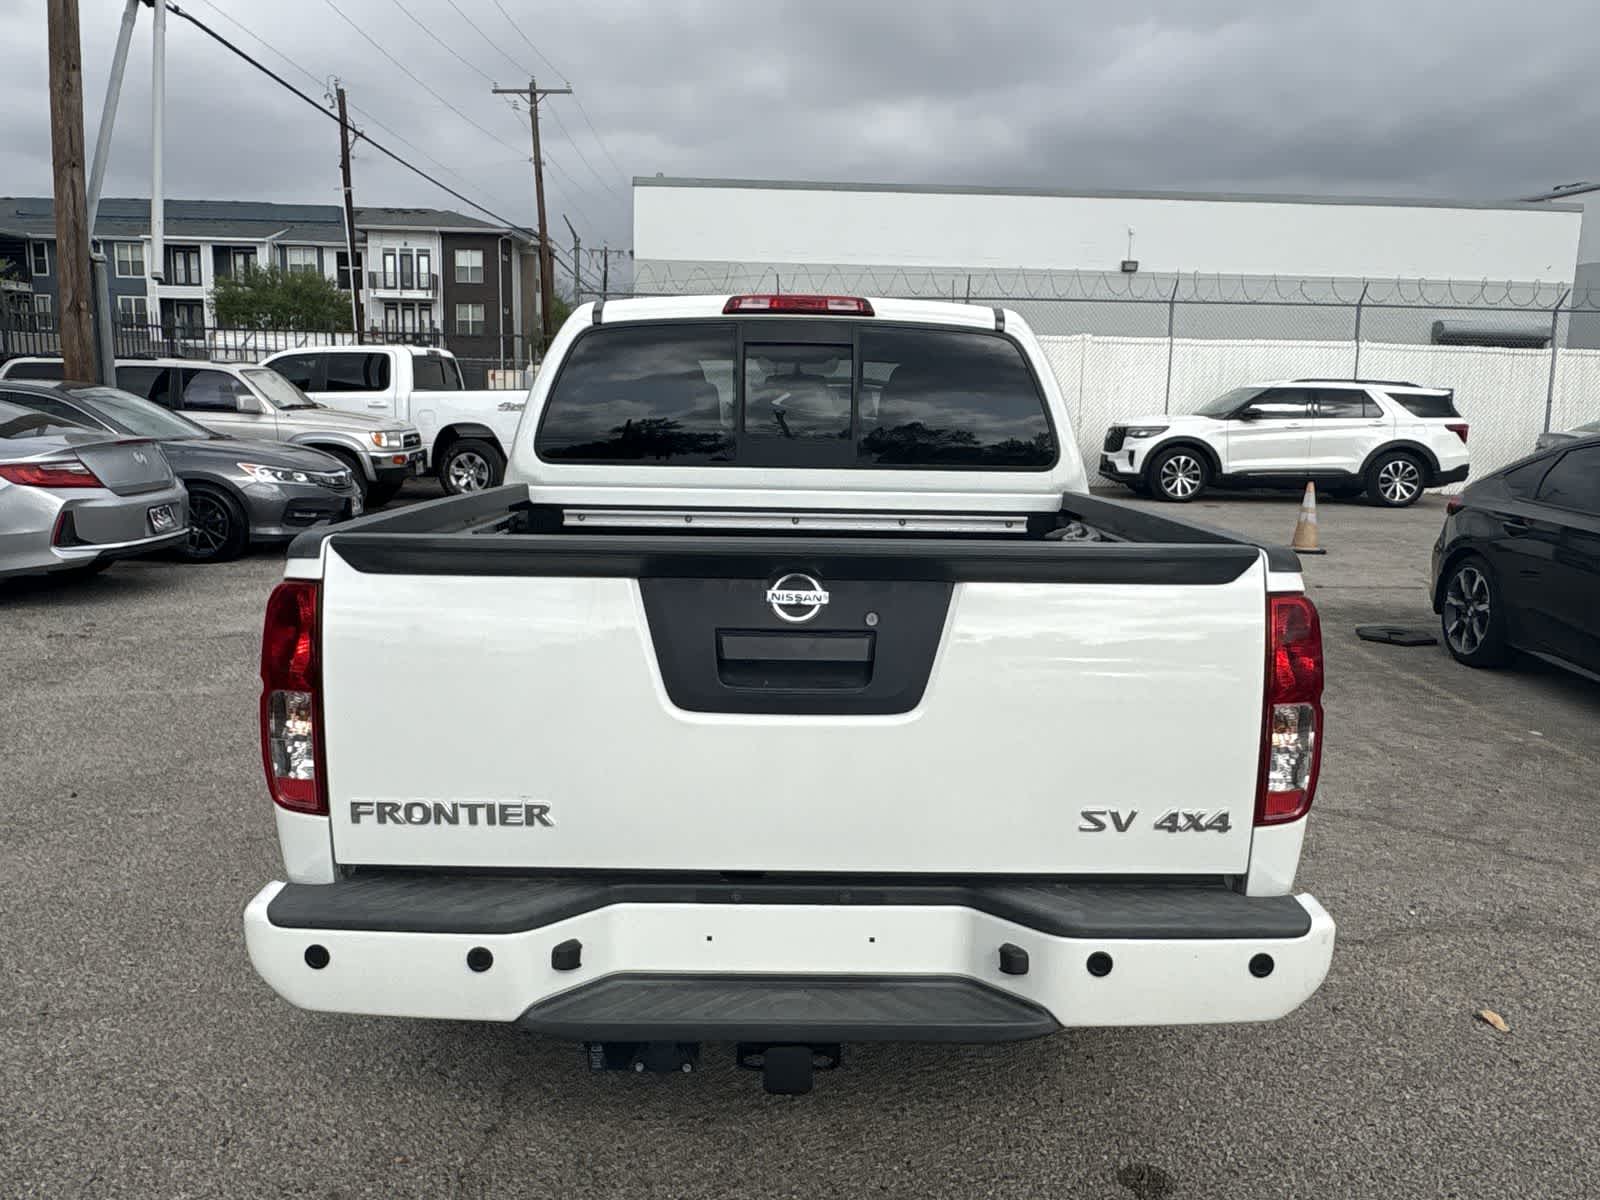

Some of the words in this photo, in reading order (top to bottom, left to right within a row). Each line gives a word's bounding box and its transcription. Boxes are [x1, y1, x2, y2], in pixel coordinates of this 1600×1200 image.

[770, 592, 823, 602] NISSAN
[350, 800, 555, 827] FRONTIER
[1078, 809, 1138, 833] SV
